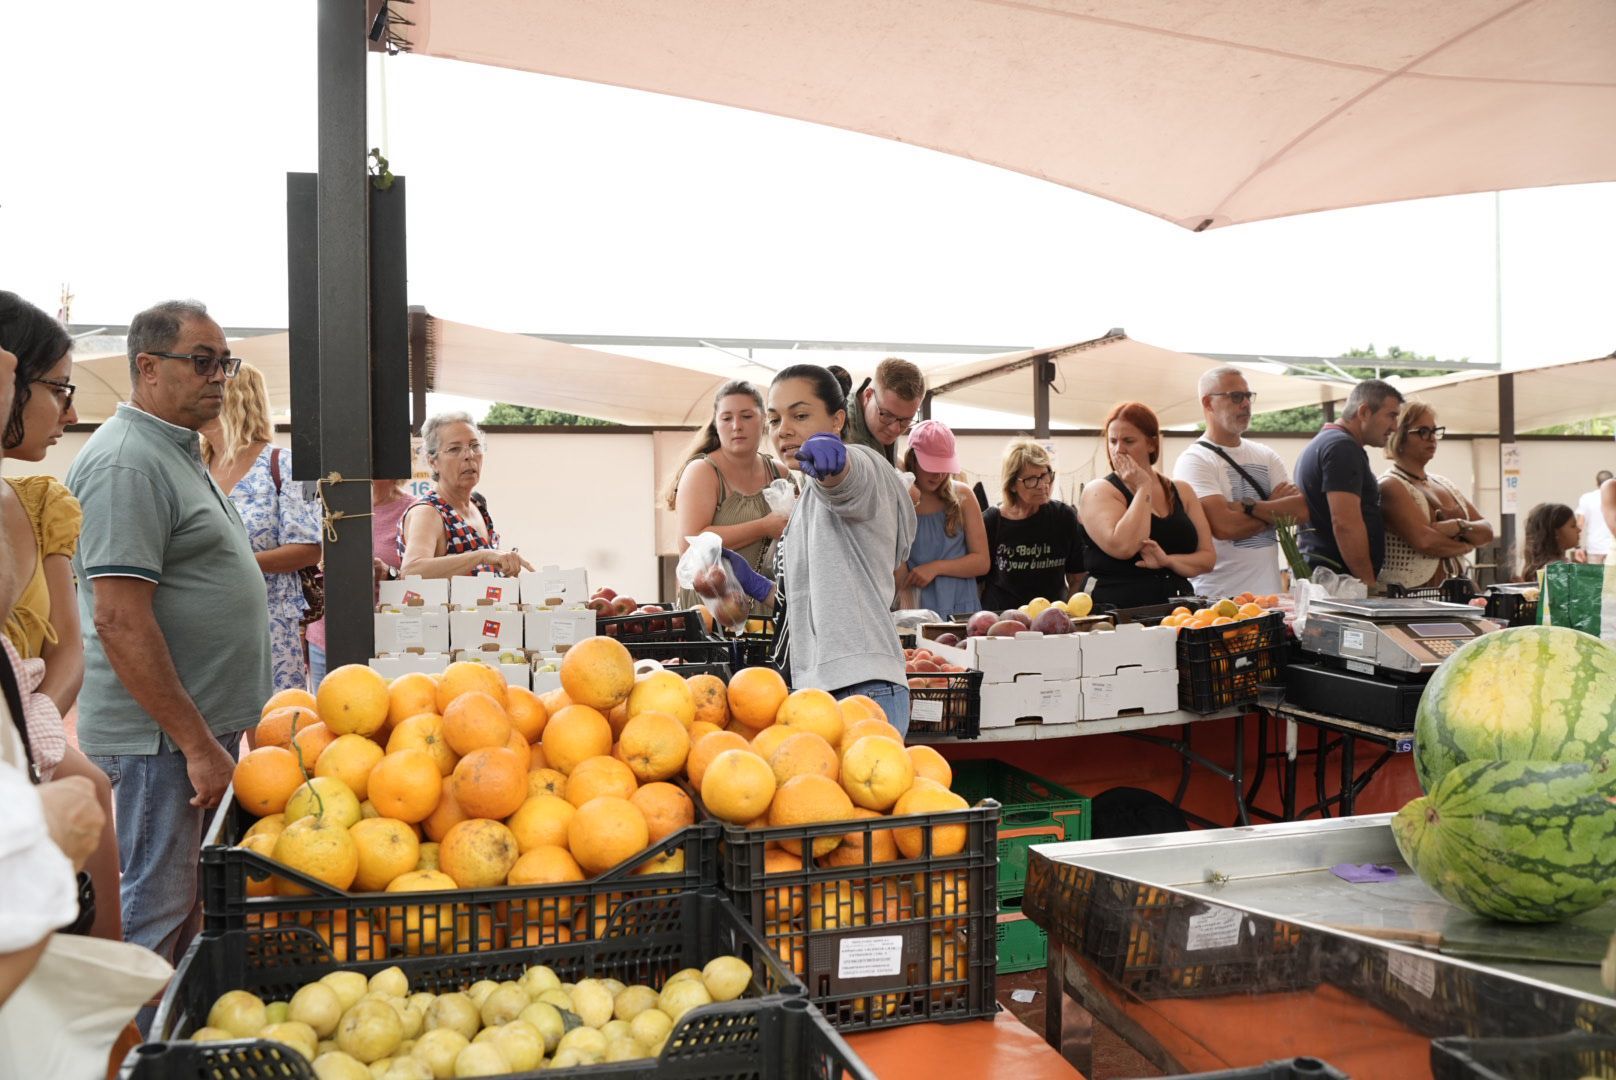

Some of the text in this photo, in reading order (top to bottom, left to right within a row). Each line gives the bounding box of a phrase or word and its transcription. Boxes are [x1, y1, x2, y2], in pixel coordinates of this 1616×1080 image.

[410, 482, 430, 495] 16
[1506, 477, 1518, 488] 18
[997, 544, 1015, 558] My
[1016, 543, 1042, 558] Body
[1007, 560, 1029, 572] your
[1030, 557, 1066, 569] business
